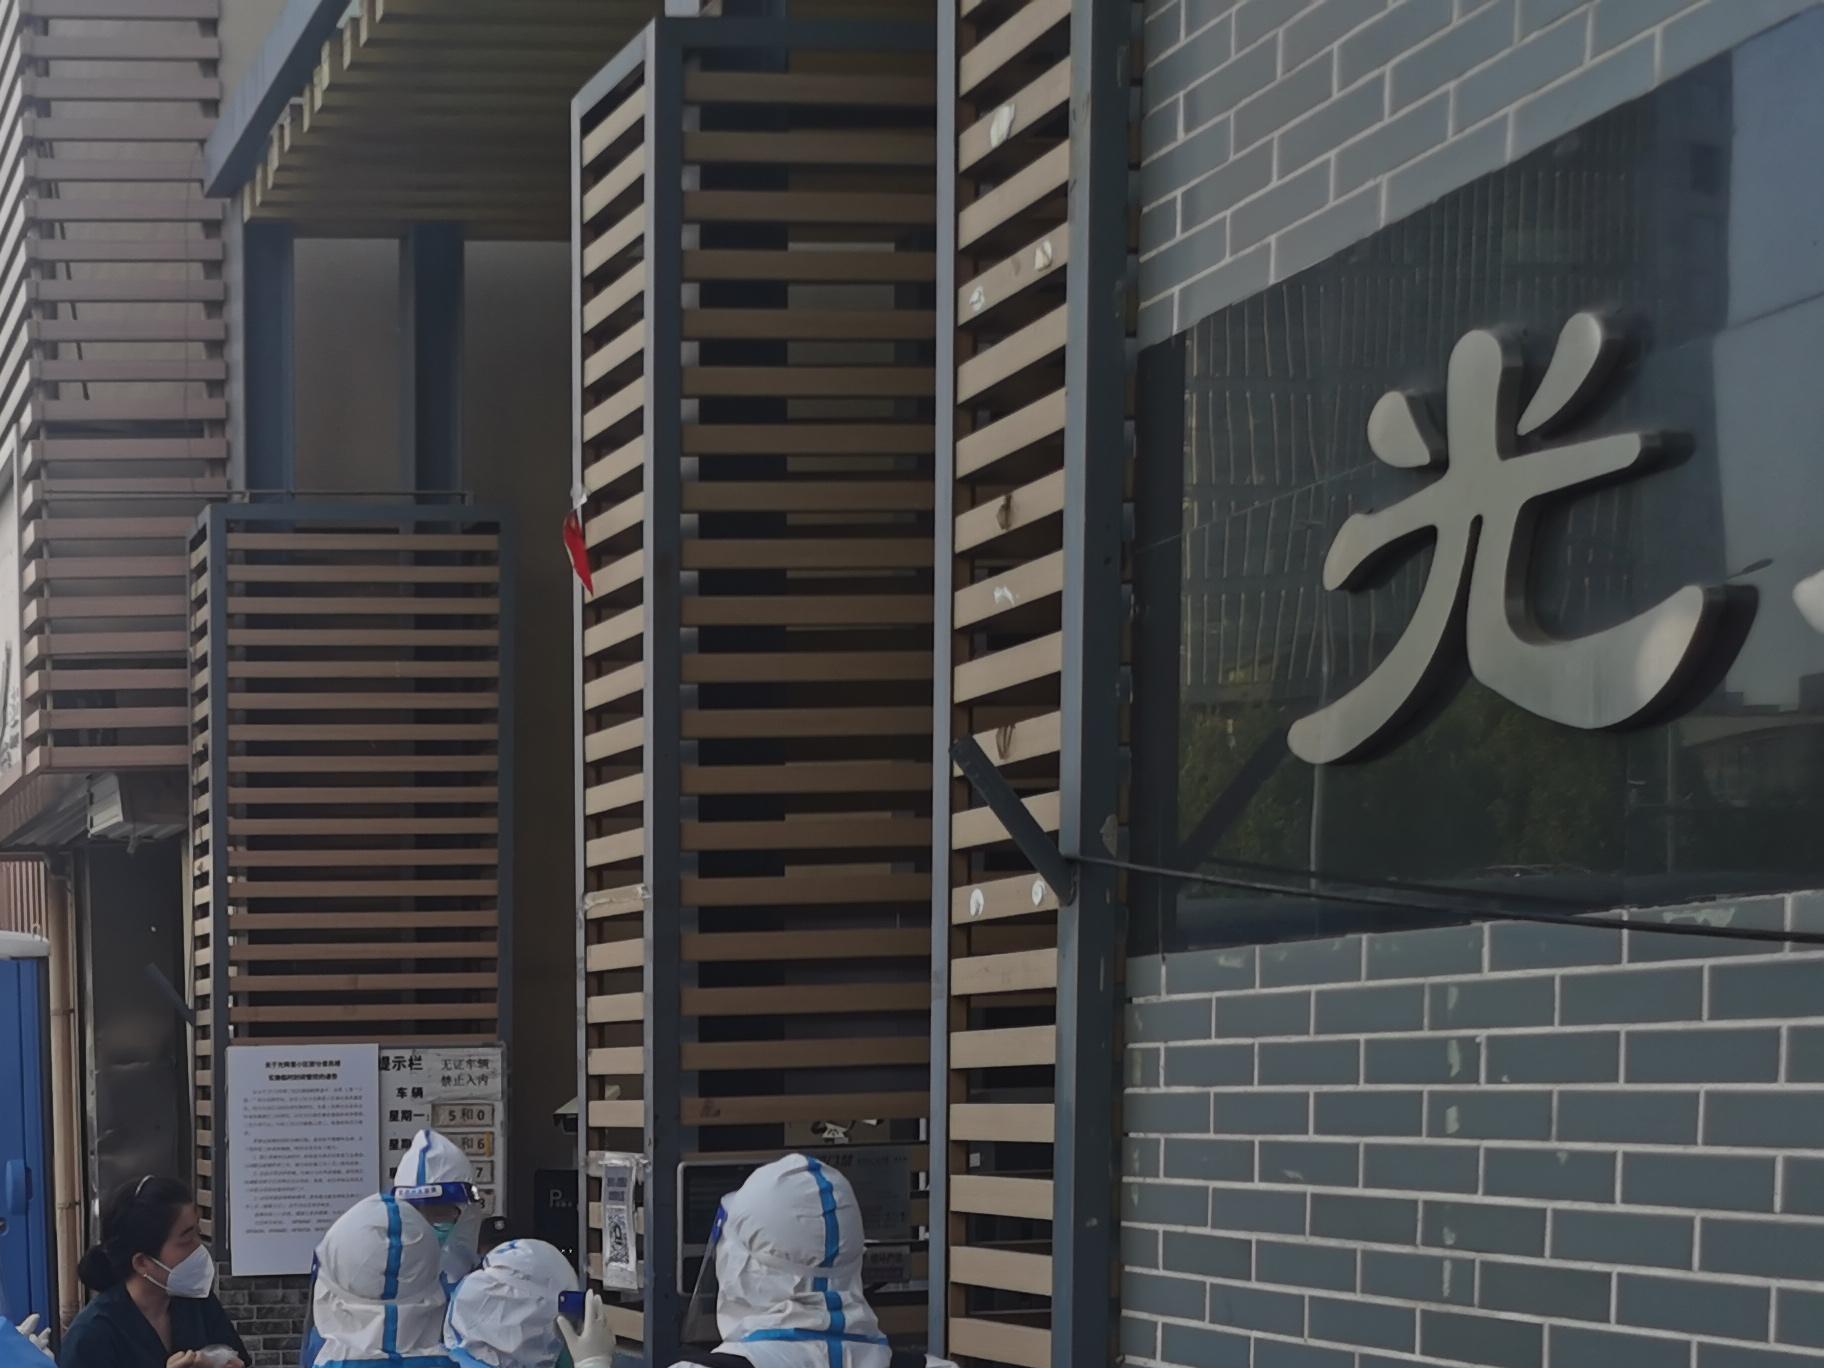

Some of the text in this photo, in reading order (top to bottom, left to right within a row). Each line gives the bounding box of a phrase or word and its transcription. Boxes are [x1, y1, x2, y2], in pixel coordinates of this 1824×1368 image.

[1287, 311, 1706, 764] 光
[441, 1058, 490, 1072] 无证车辆
[441, 1075, 489, 1087] 禁止入内
